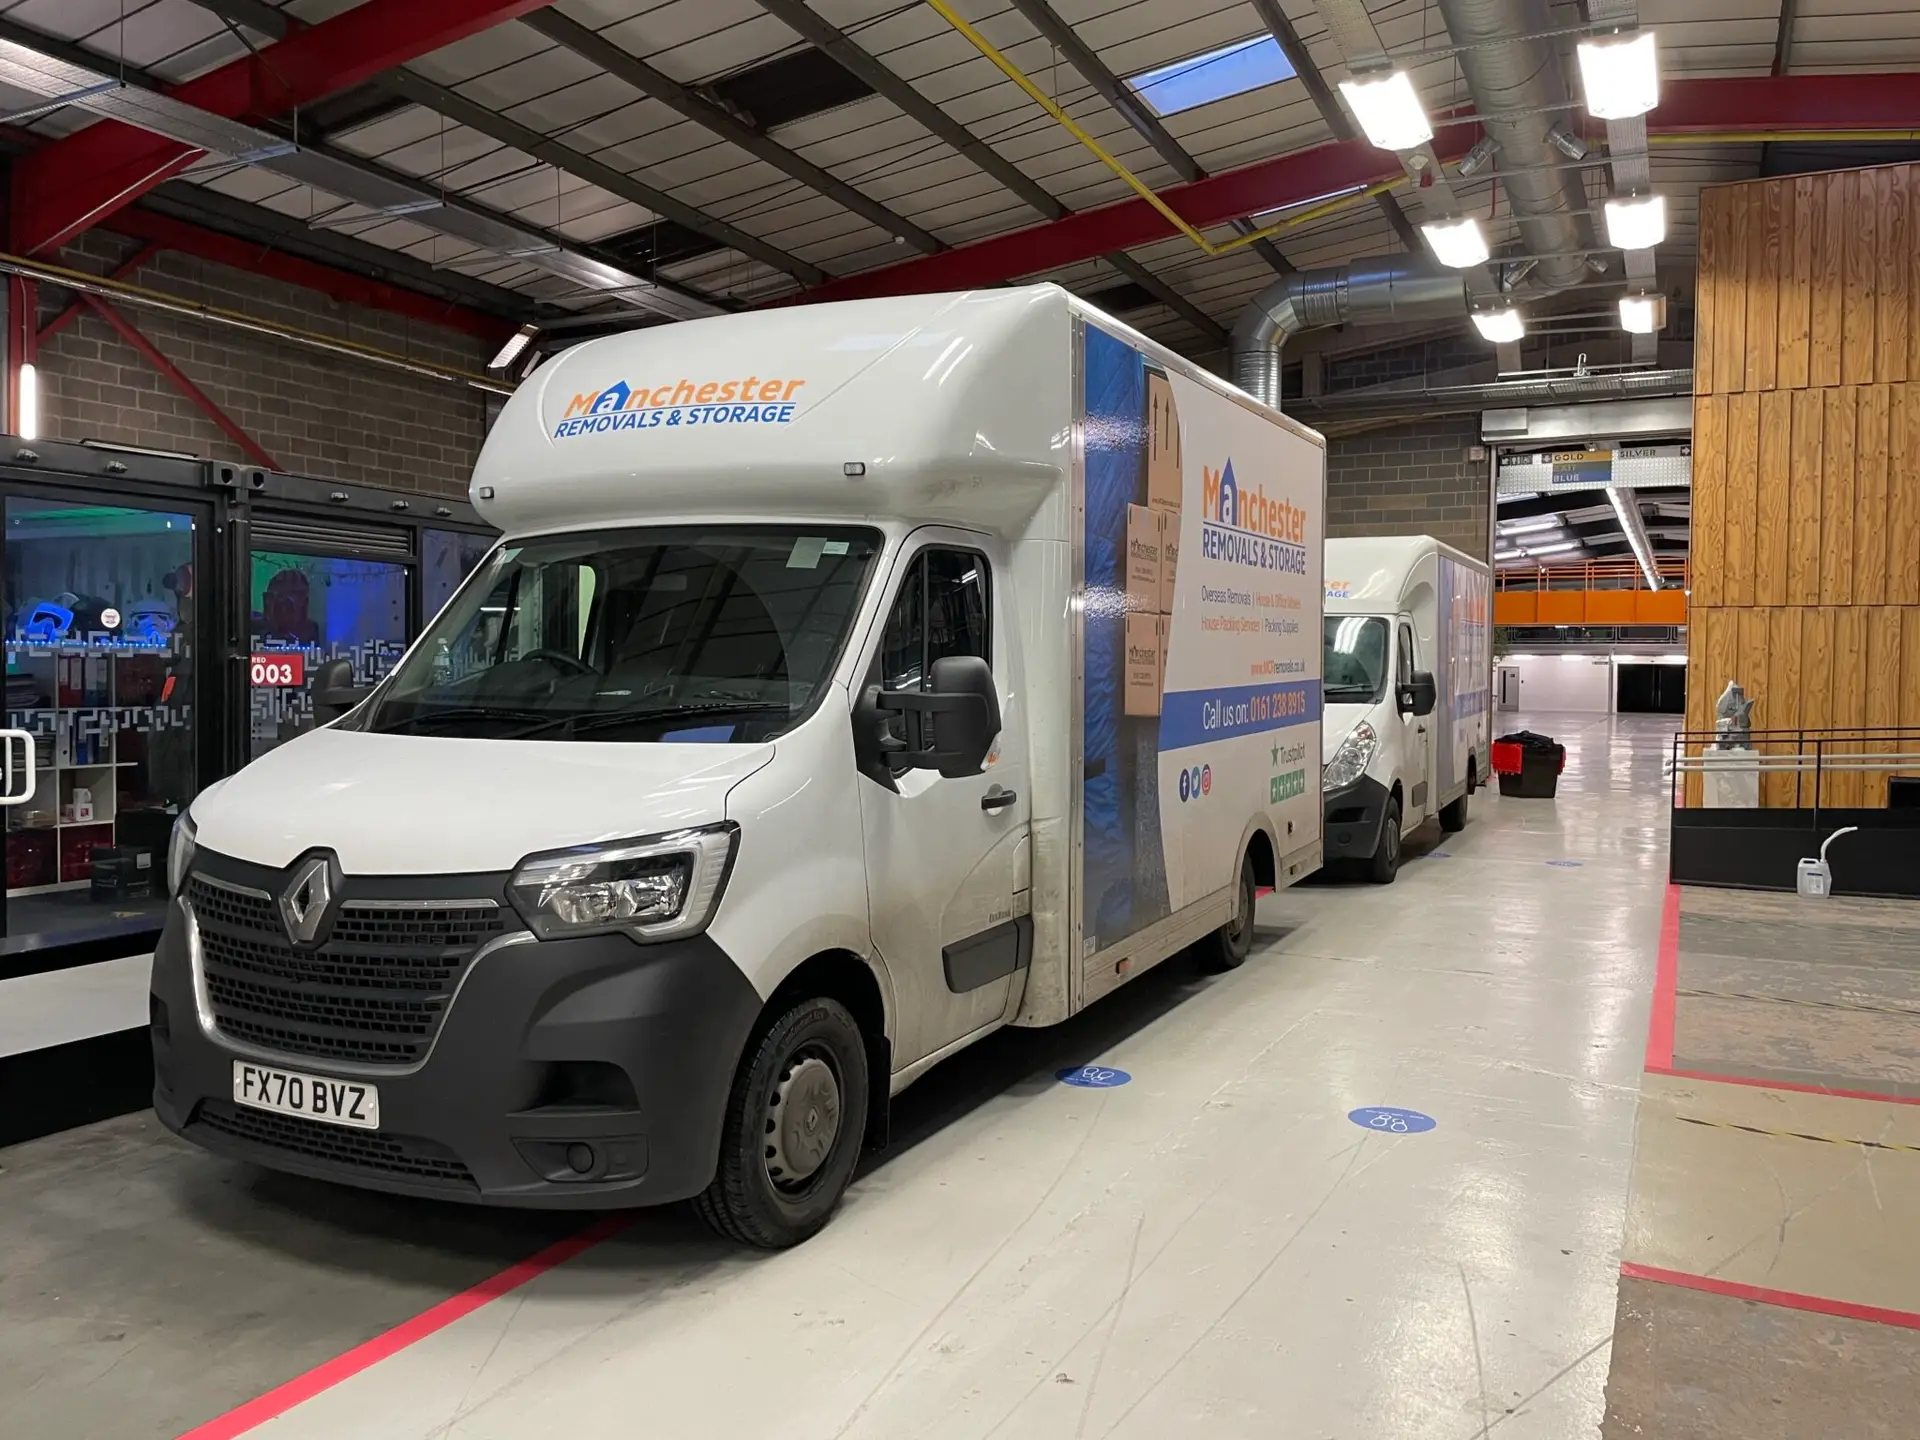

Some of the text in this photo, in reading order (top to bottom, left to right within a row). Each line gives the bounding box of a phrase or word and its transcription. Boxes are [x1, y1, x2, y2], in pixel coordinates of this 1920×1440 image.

[564, 376, 806, 418] Manchester
[554, 405, 795, 438] REMOVALS & STORAGE
[1554, 453, 1584, 461] GOLD
[1620, 450, 1656, 458] SILVER
[1553, 474, 1580, 482] BLUE
[1202, 456, 1306, 543] Manchester
[1203, 528, 1258, 567] REMOVALS
[1260, 542, 1267, 568] &
[1268, 544, 1306, 575] STORAGE
[1202, 585, 1226, 604] Overseas
[1227, 588, 1251, 606] Removals
[1201, 614, 1299, 636] House Packing Services Packing Supplies
[251, 664, 292, 684] 003
[1203, 690, 1305, 730] Call us on: 0161 238 8915
[1280, 741, 1305, 765] Trustpilot
[243, 1066, 366, 1120] FX70 BVZ
